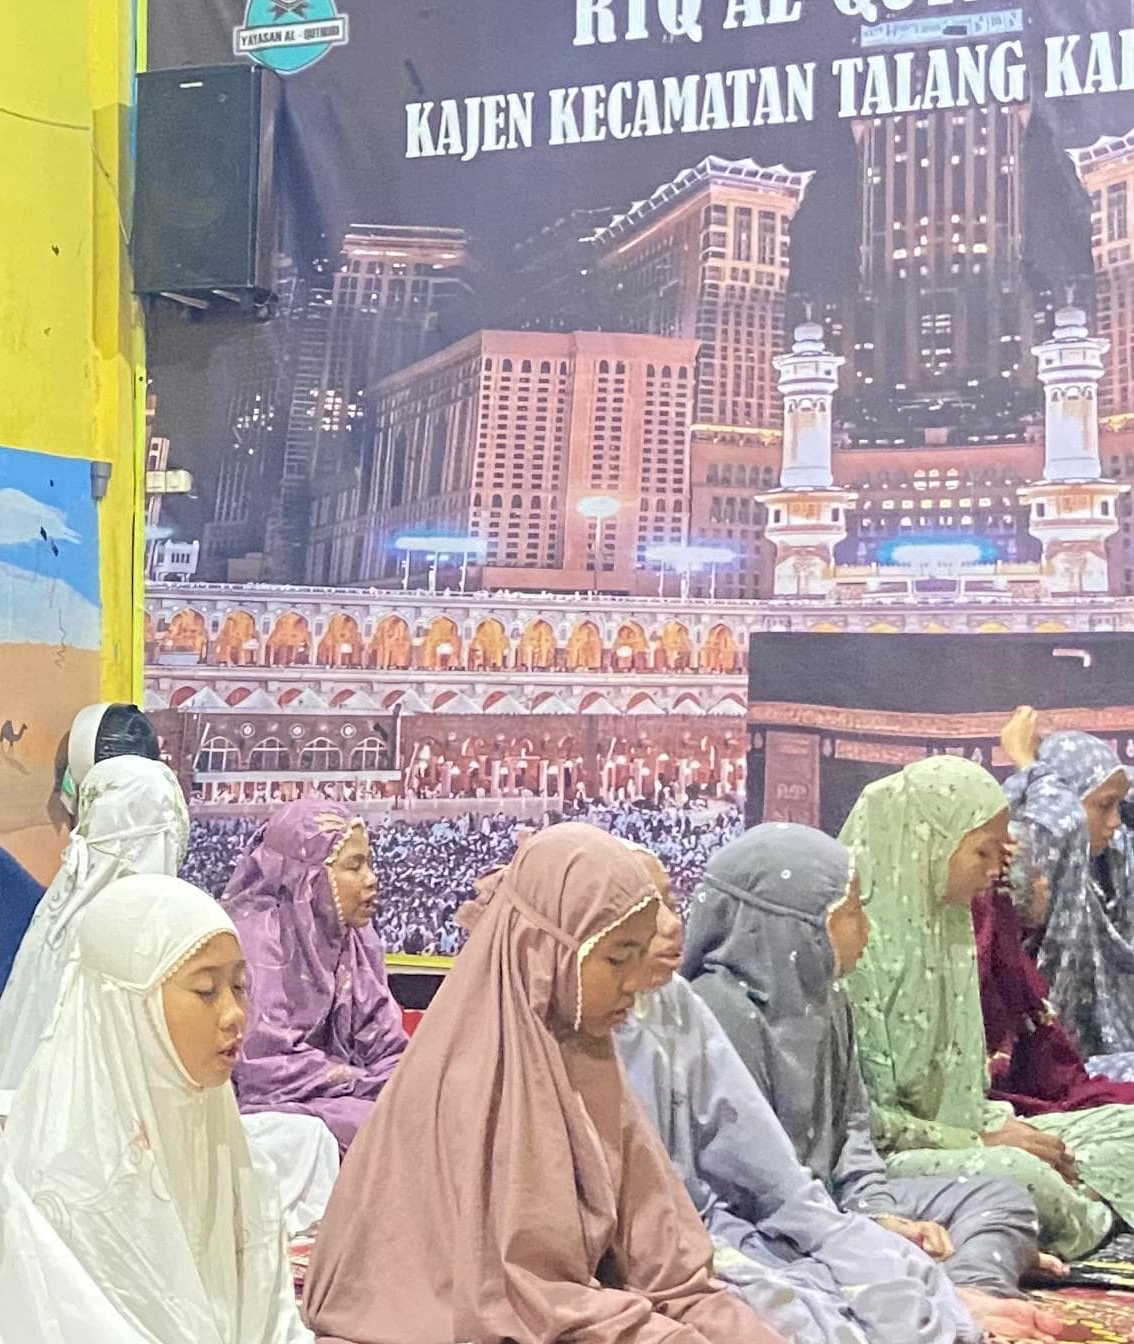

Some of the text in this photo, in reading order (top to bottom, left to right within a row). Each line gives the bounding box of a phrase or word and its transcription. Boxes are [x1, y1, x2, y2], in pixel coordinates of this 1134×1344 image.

[241, 30, 282, 47] YAYASAN
[405, 91, 534, 162] KAJEN
[548, 62, 817, 145] KECAMATAN
[832, 40, 1027, 118] TALANG
